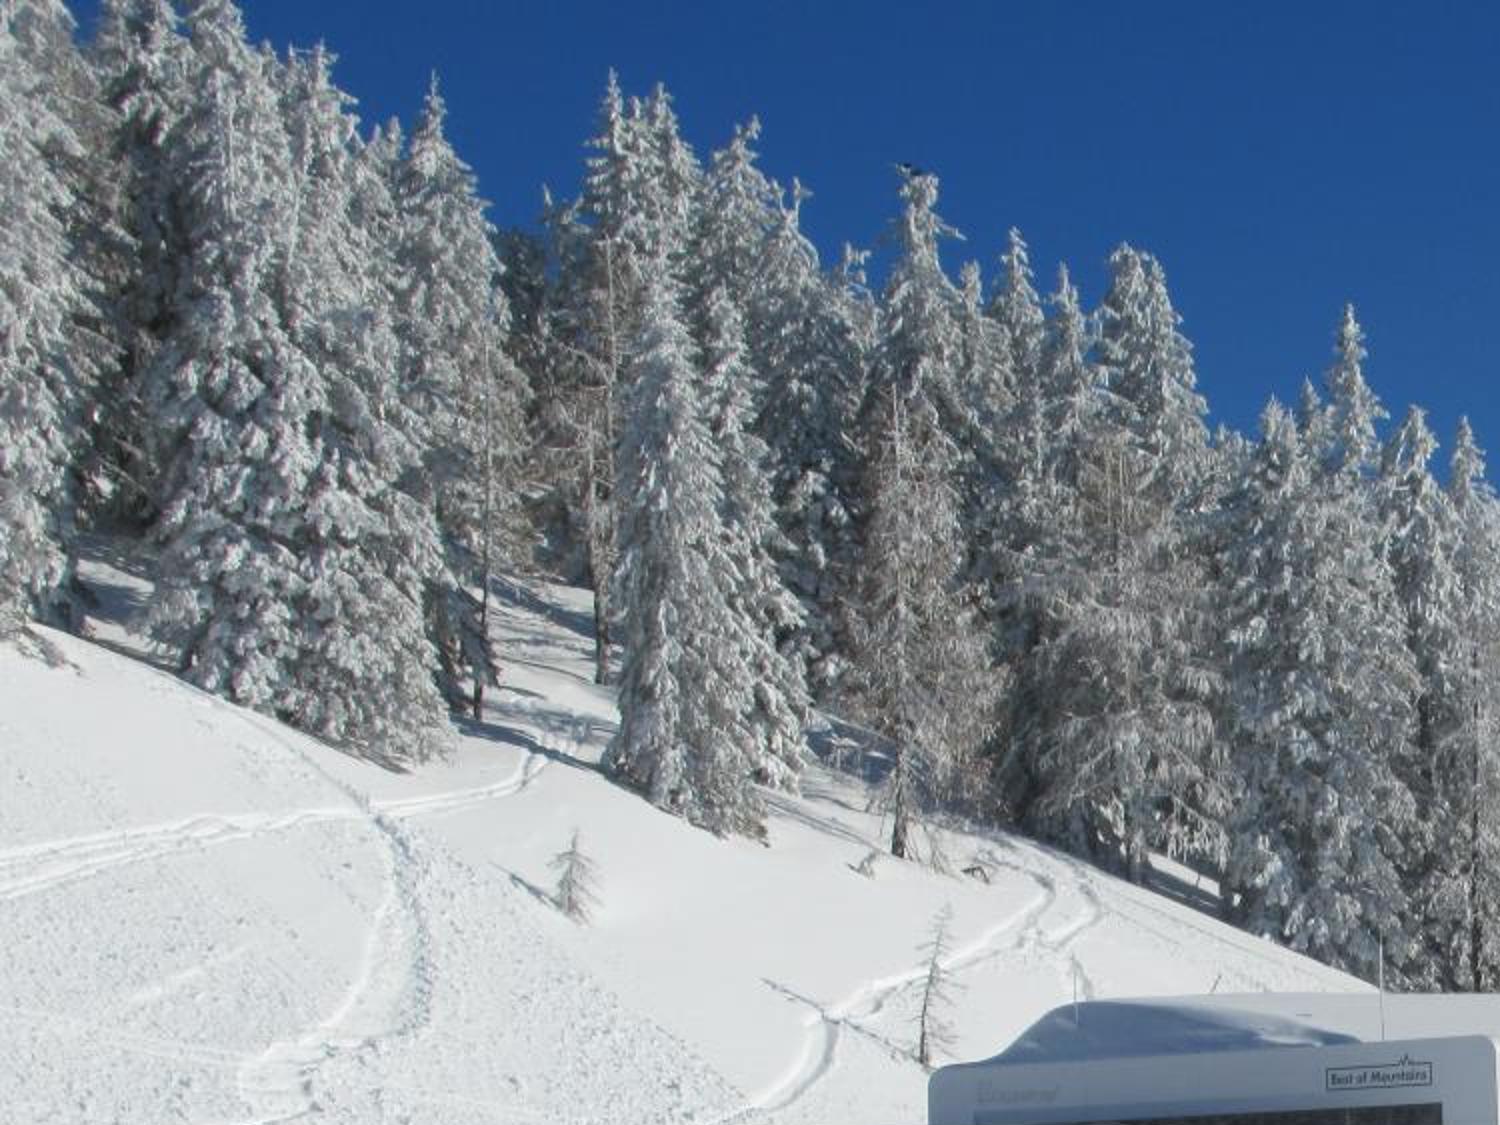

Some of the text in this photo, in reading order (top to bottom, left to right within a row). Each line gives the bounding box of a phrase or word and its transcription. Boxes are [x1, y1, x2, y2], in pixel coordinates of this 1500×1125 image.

[1331, 1070, 1427, 1085] Best of Mountains
